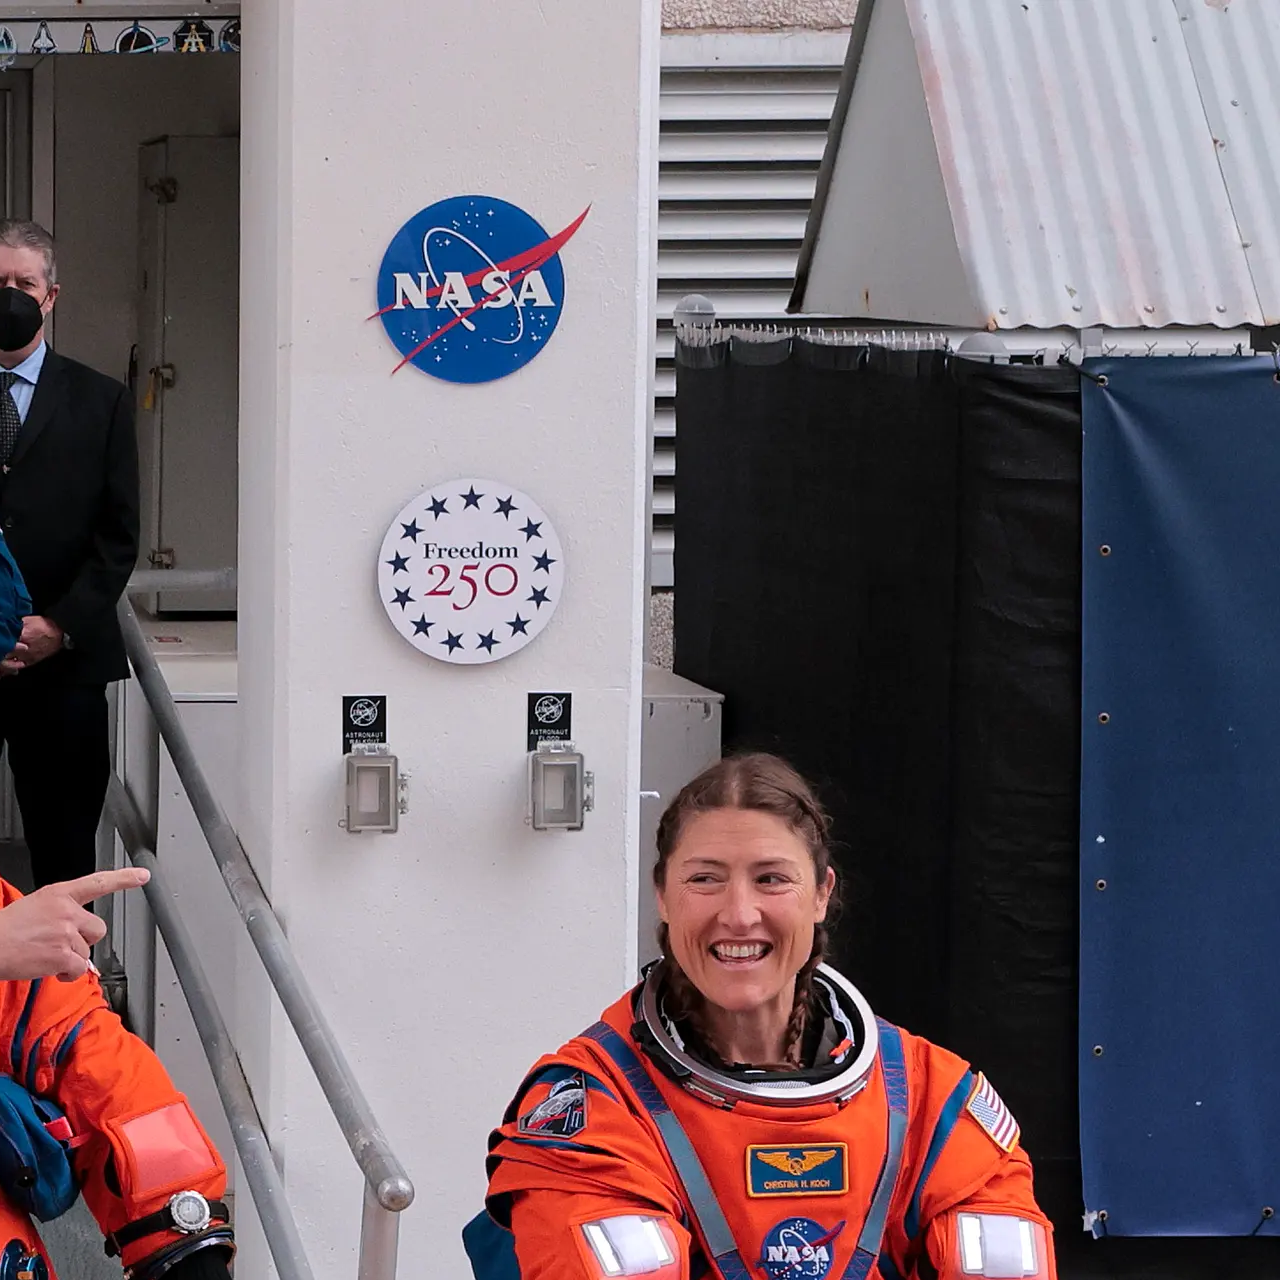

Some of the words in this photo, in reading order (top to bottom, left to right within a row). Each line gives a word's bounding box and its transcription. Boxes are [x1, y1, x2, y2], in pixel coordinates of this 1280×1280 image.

[393, 269, 555, 310] NASA
[423, 541, 519, 560] Freedom
[423, 562, 519, 611] 250
[763, 1180, 798, 1190] CHRISTINA
[810, 1179, 830, 1188] KOCH
[767, 1246, 830, 1262] NASA
